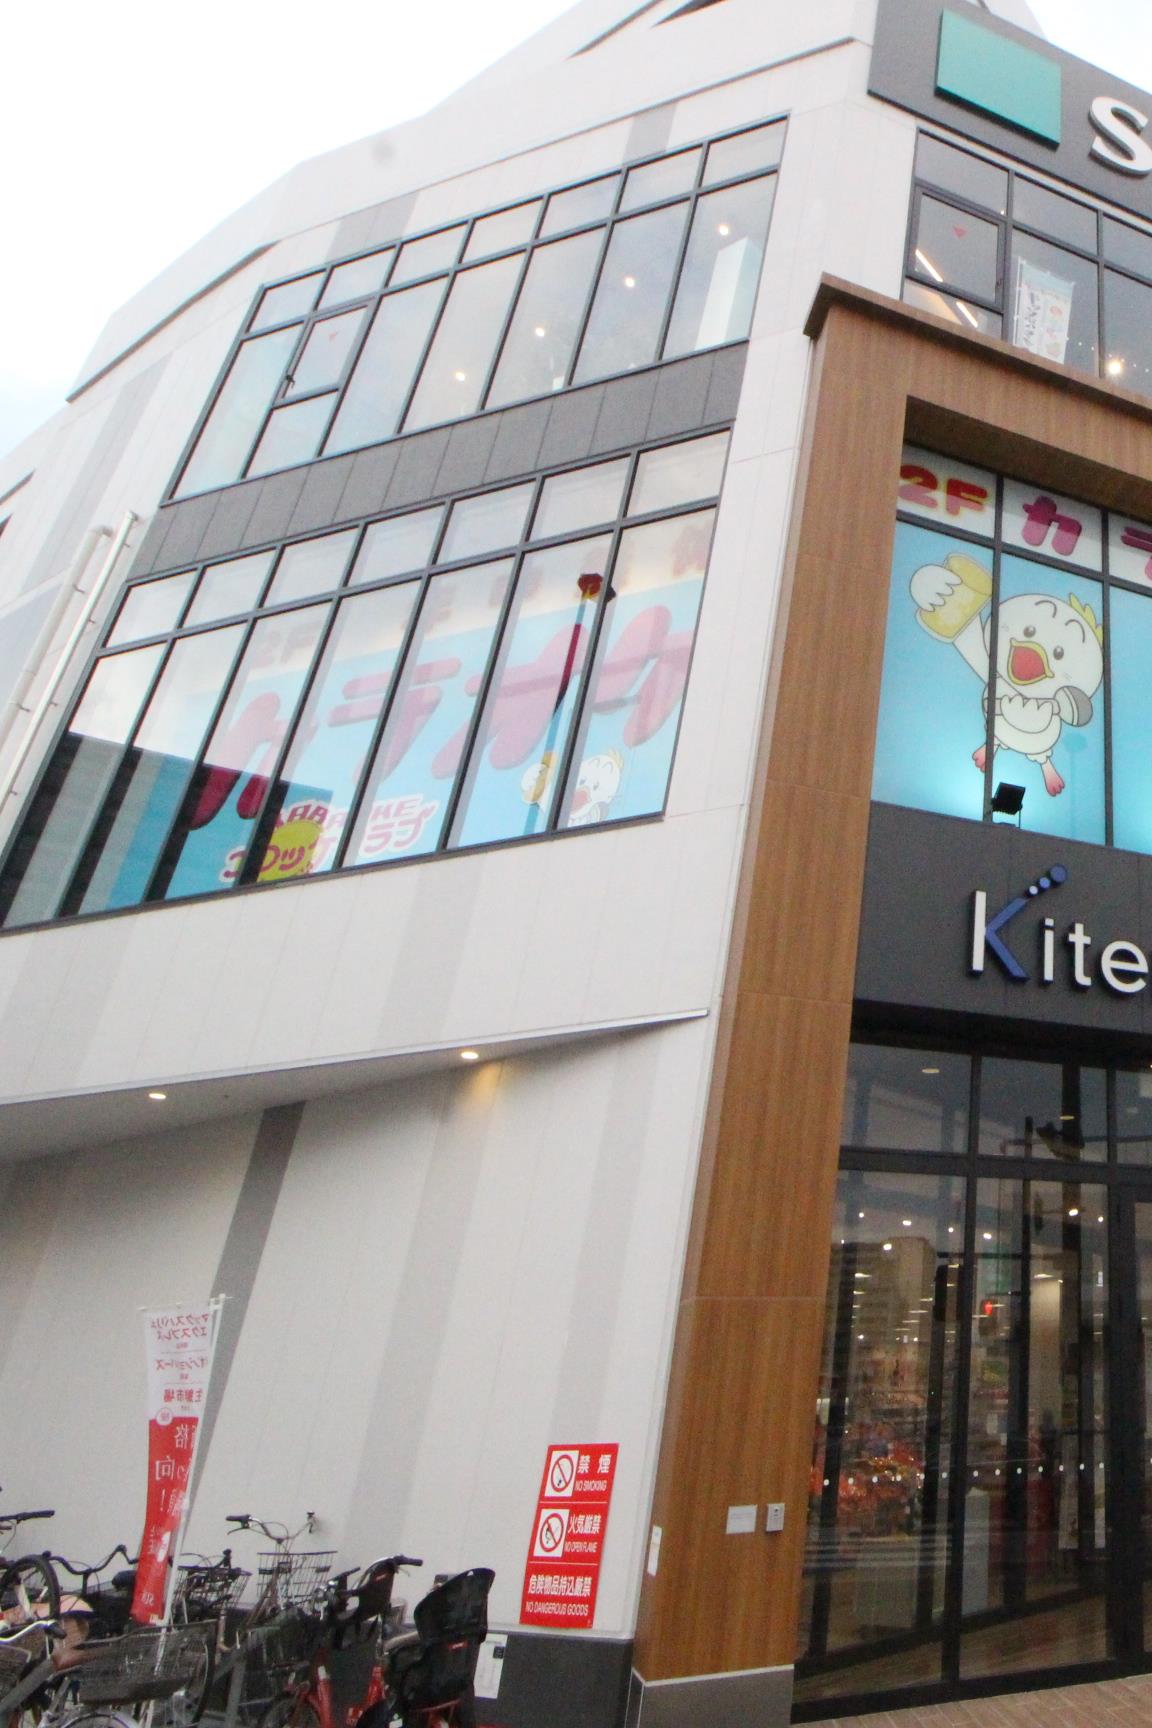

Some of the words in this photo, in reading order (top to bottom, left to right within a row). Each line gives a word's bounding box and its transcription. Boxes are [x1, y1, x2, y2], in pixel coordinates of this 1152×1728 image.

[900, 464, 988, 516] 2F
[577, 1454, 612, 1474] 禁煙
[575, 1480, 583, 1491] NO
[583, 1480, 607, 1491] SMOKING
[568, 1514, 602, 1535] 火気厳禁
[528, 1575, 592, 1597] 危険物品持込厳禁
[525, 1602, 534, 1613] NO
[534, 1602, 567, 1615] DANGEROUS
[567, 1604, 588, 1617] GOODS
